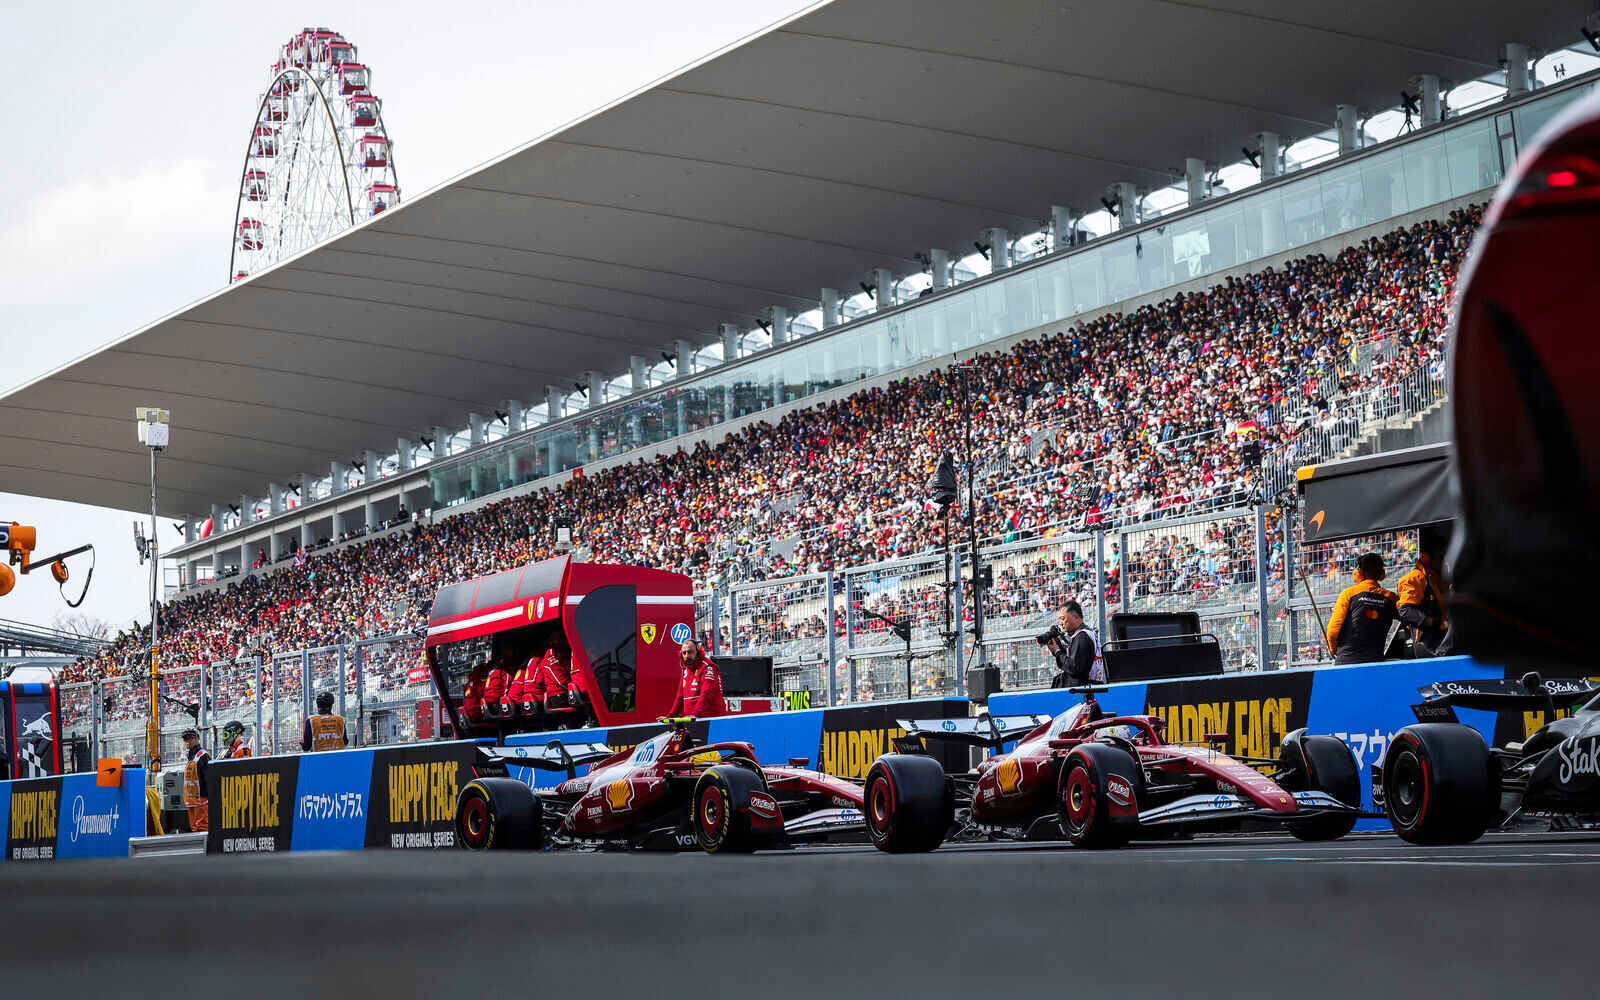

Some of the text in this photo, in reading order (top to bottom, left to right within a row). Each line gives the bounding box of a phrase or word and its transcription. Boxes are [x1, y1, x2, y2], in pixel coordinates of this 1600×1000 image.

[673, 624, 689, 643] hp
[1447, 683, 1480, 694] Stake
[1545, 680, 1581, 694] Stake
[1422, 706, 1450, 717] Libertex
[944, 721, 955, 731] hp
[517, 748, 526, 757] hp
[638, 741, 653, 765] hp
[1559, 736, 1600, 784] Stak
[221, 773, 280, 831] HAPPY FACE
[389, 763, 428, 827] HAPPY
[430, 761, 458, 823] FACE
[300, 792, 363, 820] パラマウントプラス
[12, 790, 57, 842] HAPPY FACE
[71, 795, 119, 842] Paramount+
[223, 837, 274, 852] NEW ORIGINAL SERIES
[392, 831, 454, 848] NEW ORIGINAL SERIES
[13, 846, 53, 859] NEW ORIGINAL SERIES
